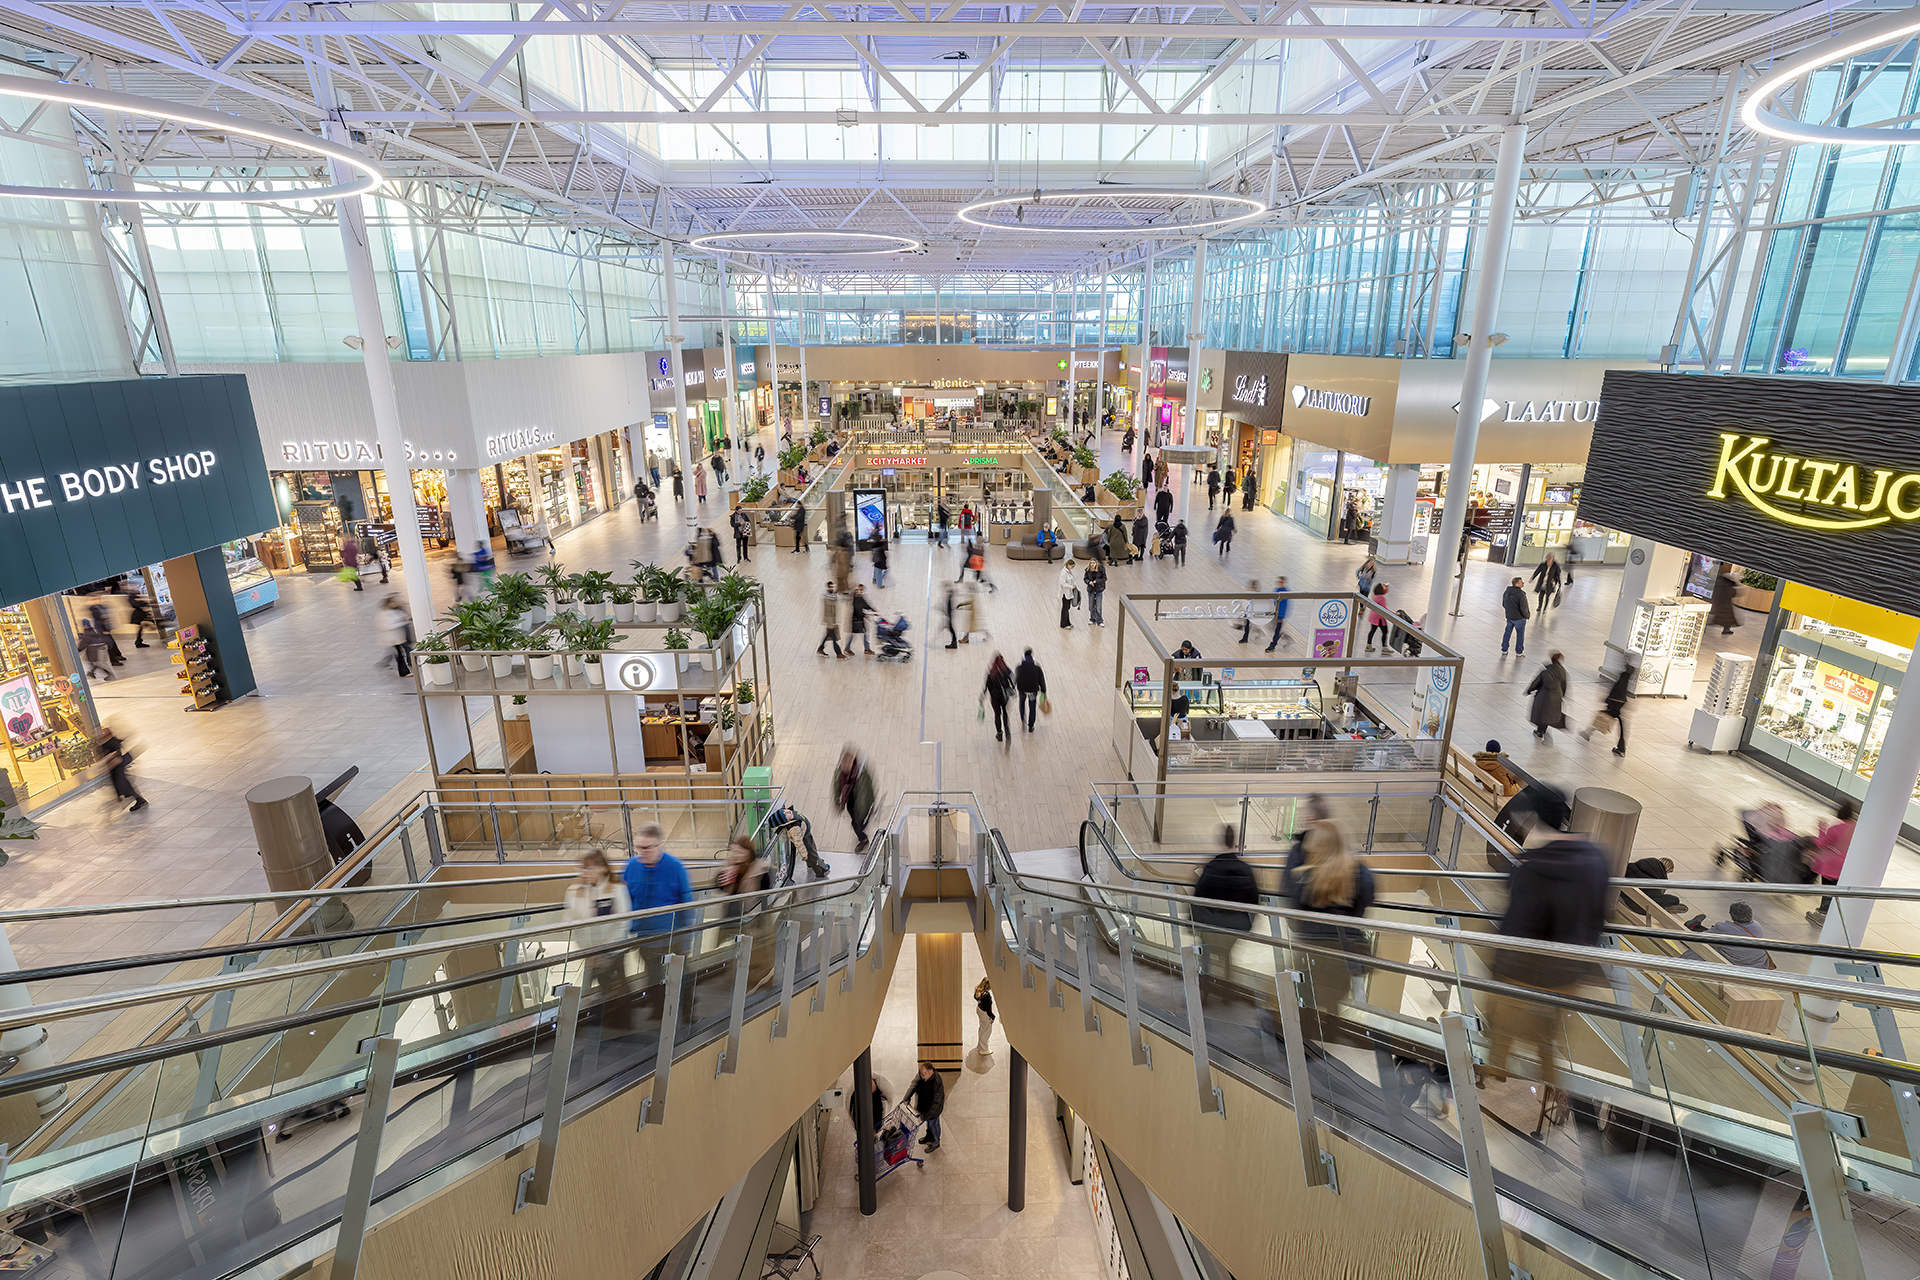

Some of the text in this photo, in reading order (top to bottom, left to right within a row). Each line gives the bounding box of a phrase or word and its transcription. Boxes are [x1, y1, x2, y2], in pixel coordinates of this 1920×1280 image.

[933, 378, 969, 390] picnic
[1232, 375, 1260, 404] Lindt
[1305, 389, 1370, 417] LAATUKORU
[969, 457, 999, 465] PRISMA
[0, 450, 215, 513] HE BODY SHOP
